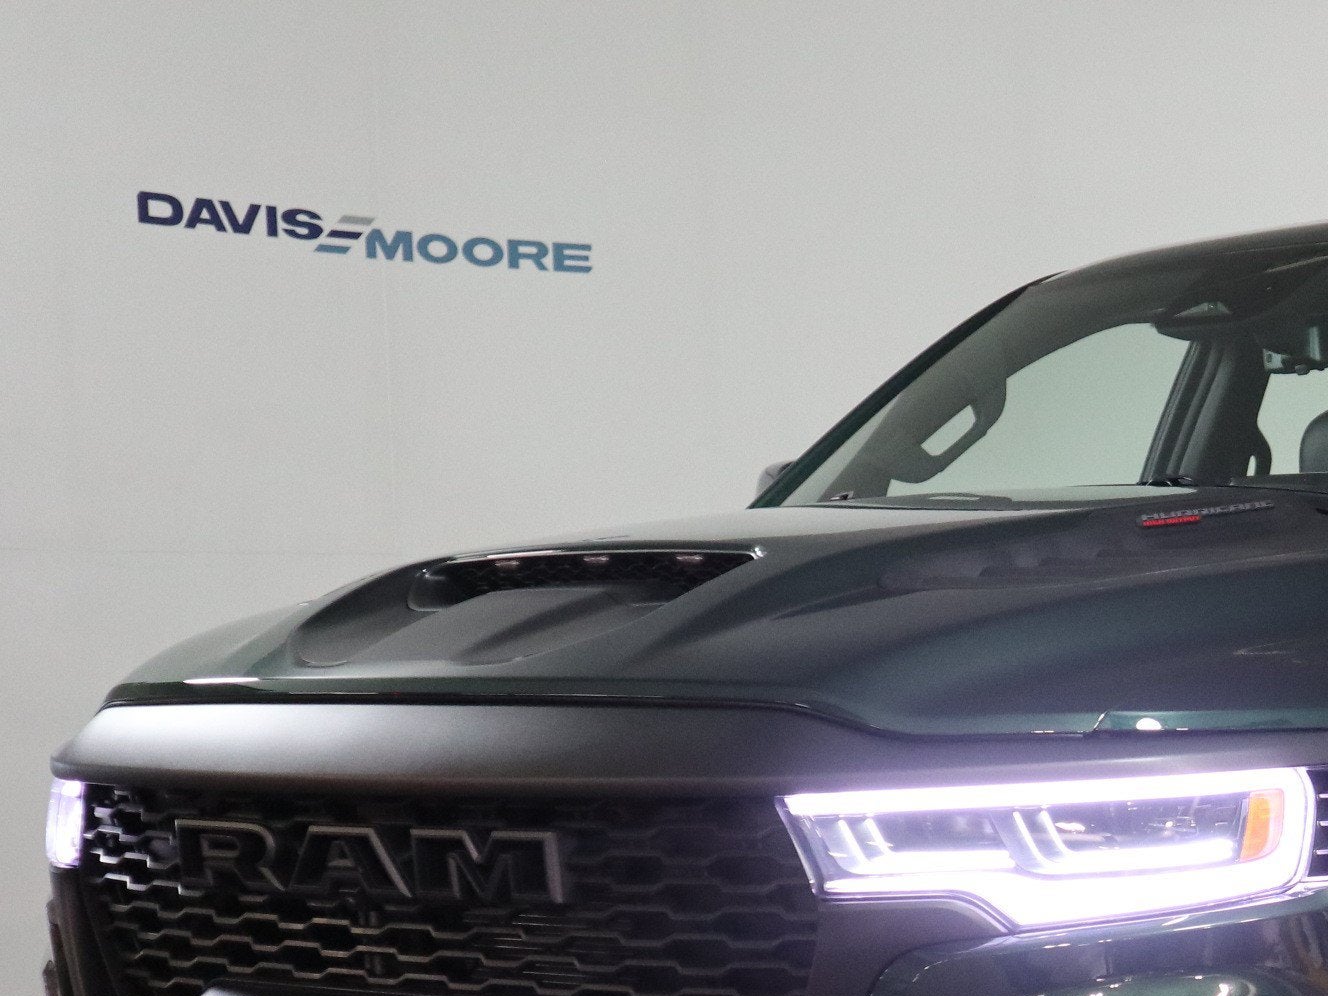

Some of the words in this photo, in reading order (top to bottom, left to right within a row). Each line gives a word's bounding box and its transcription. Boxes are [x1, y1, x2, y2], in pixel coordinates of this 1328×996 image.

[136, 190, 324, 241] DAVIS
[365, 228, 593, 274] MOORE
[174, 818, 564, 904] RAM
